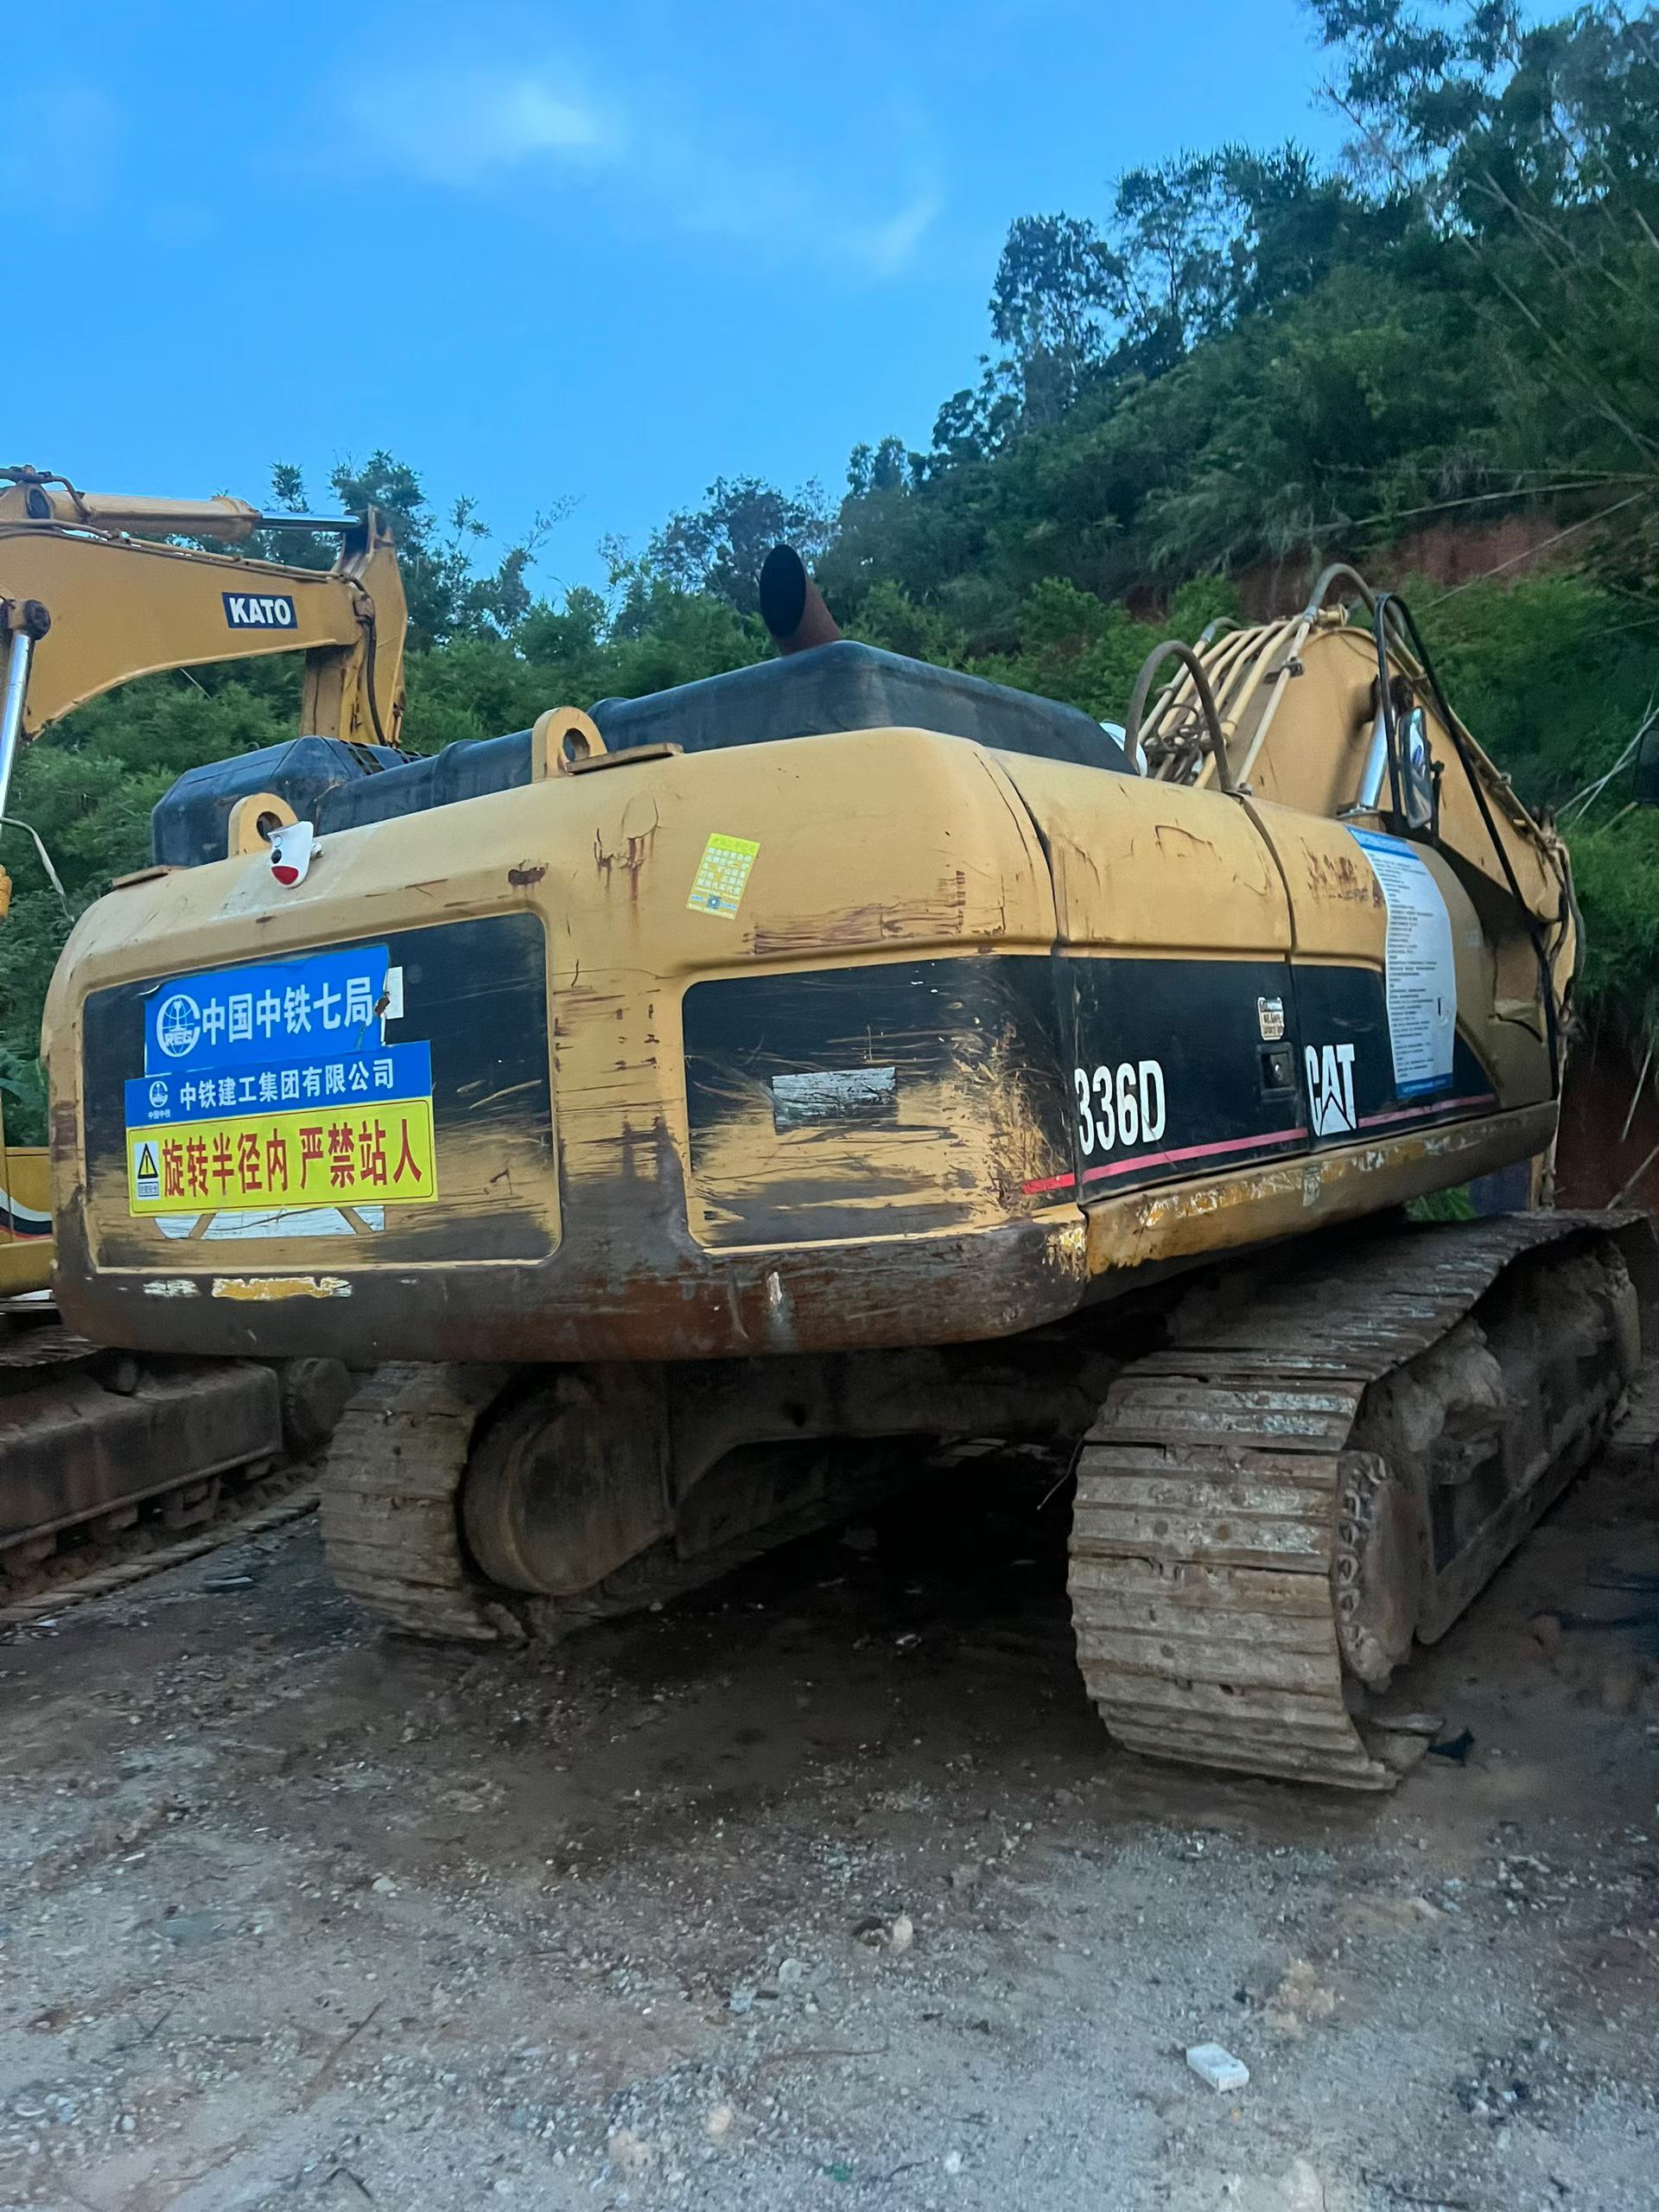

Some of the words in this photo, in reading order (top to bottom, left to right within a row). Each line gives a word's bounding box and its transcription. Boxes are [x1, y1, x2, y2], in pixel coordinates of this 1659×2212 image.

[229, 597, 291, 626] KATO
[202, 976, 373, 1046] 中国中铁七局
[180, 1058, 394, 1111] 中铁建工集团有限公司
[1074, 1059, 1166, 1156] 336D
[1305, 1044, 1357, 1137] CAT
[162, 1128, 288, 1198] 旋转半径内
[299, 1118, 422, 1191] 严禁站人
